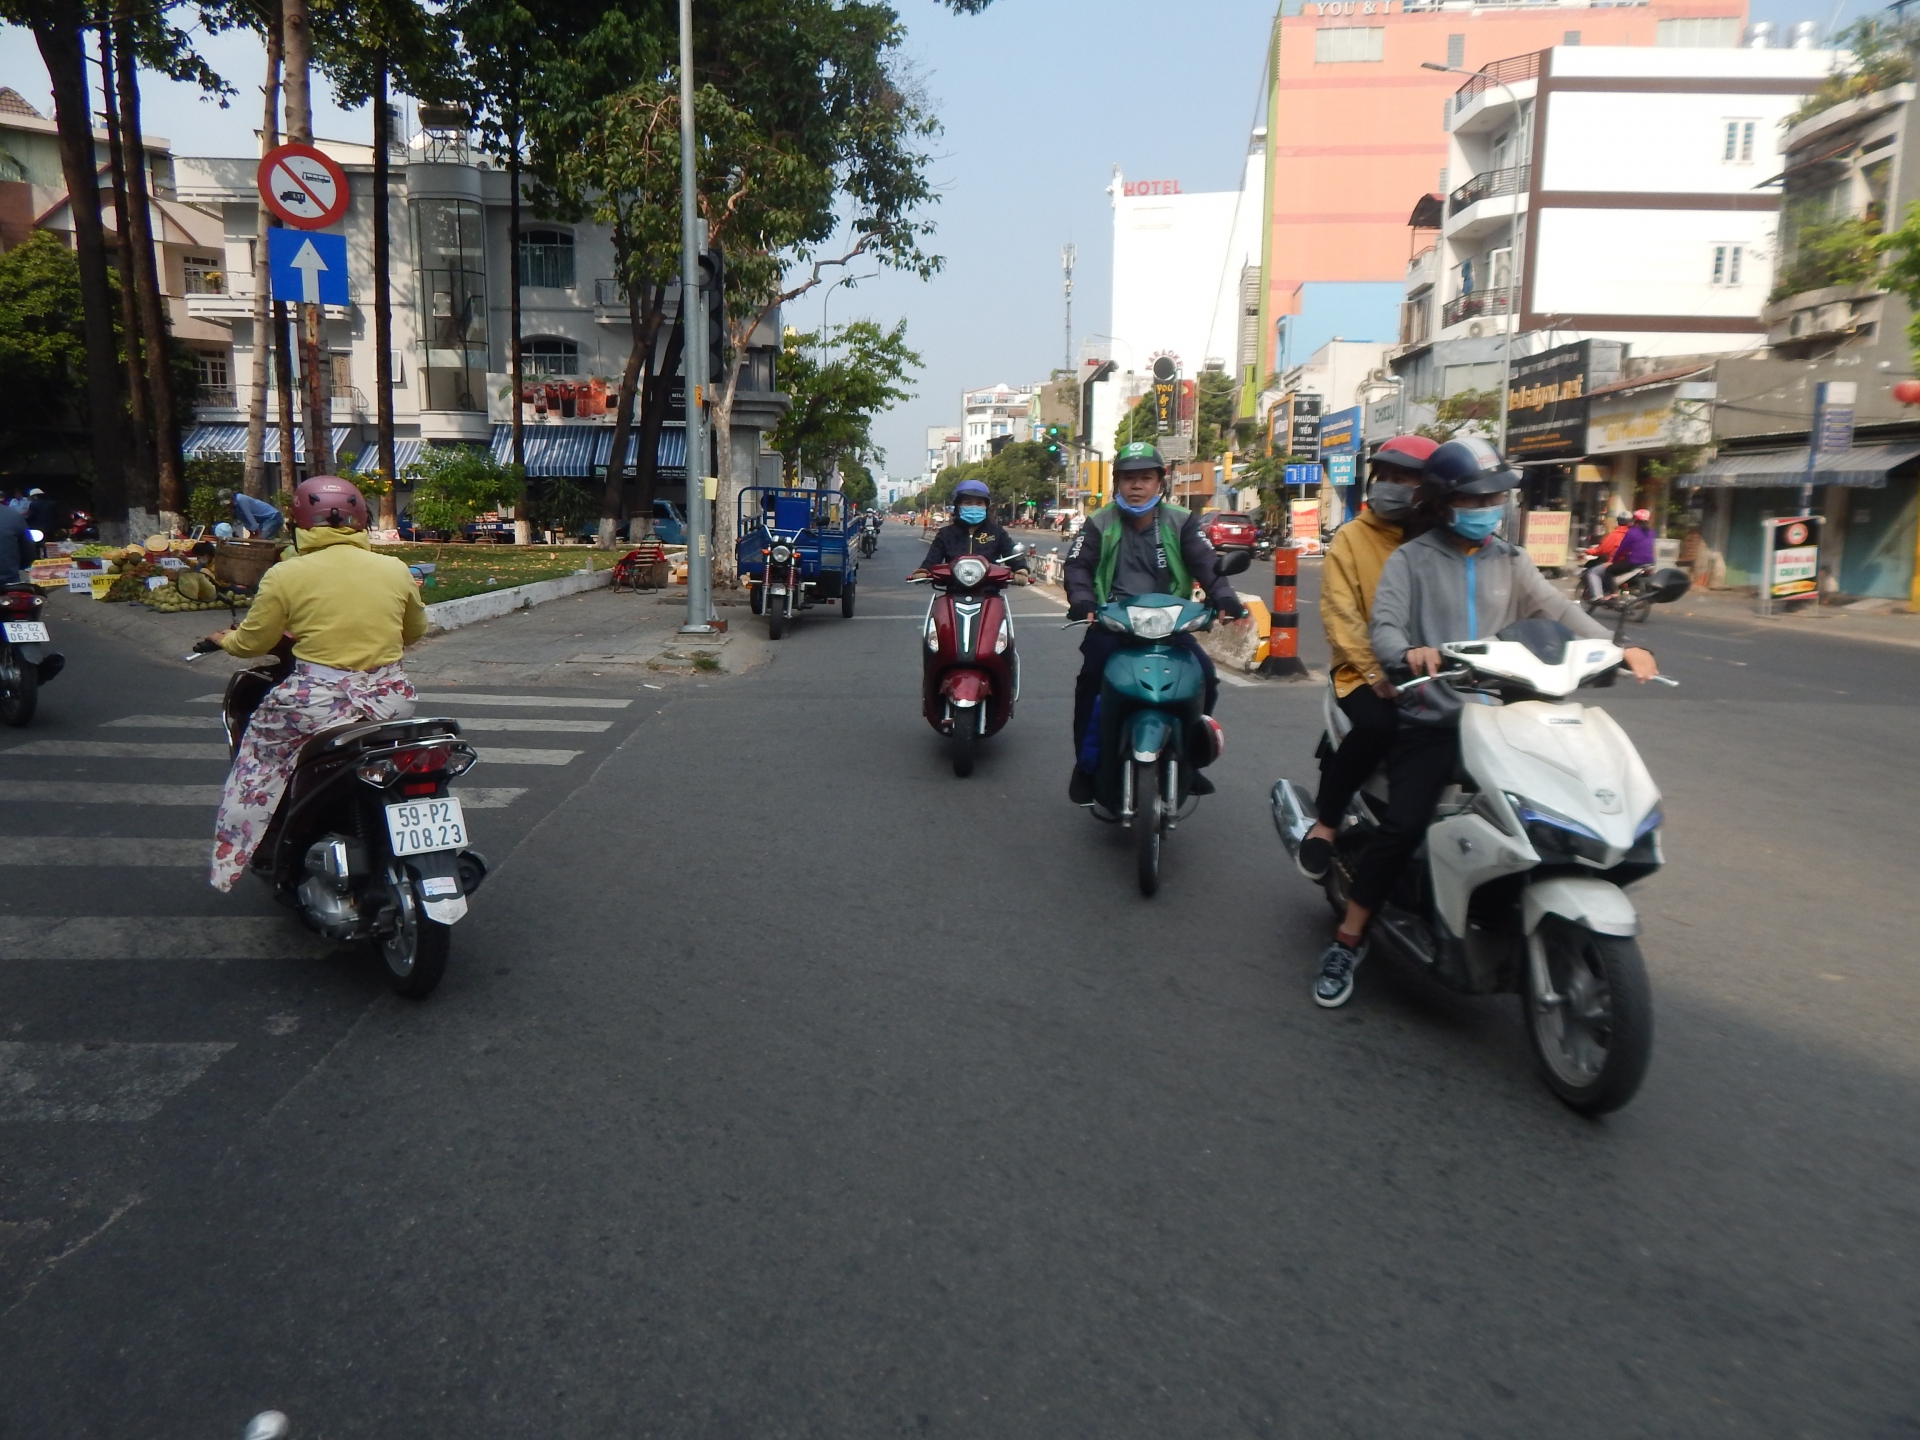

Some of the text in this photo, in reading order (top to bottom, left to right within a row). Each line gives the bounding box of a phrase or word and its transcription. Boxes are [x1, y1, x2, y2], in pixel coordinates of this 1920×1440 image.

[1316, 0, 1392, 17] YOU & I
[1123, 179, 1183, 197] HOTEL
[1145, 349, 1184, 371] KARAOKE
[1300, 424, 1312, 435] YẾN
[1331, 455, 1353, 464] DẠY
[10, 623, 40, 632] 59-G2
[10, 632, 46, 641] 062.51
[398, 802, 452, 827] 59-P2
[396, 824, 462, 852] 708.23
